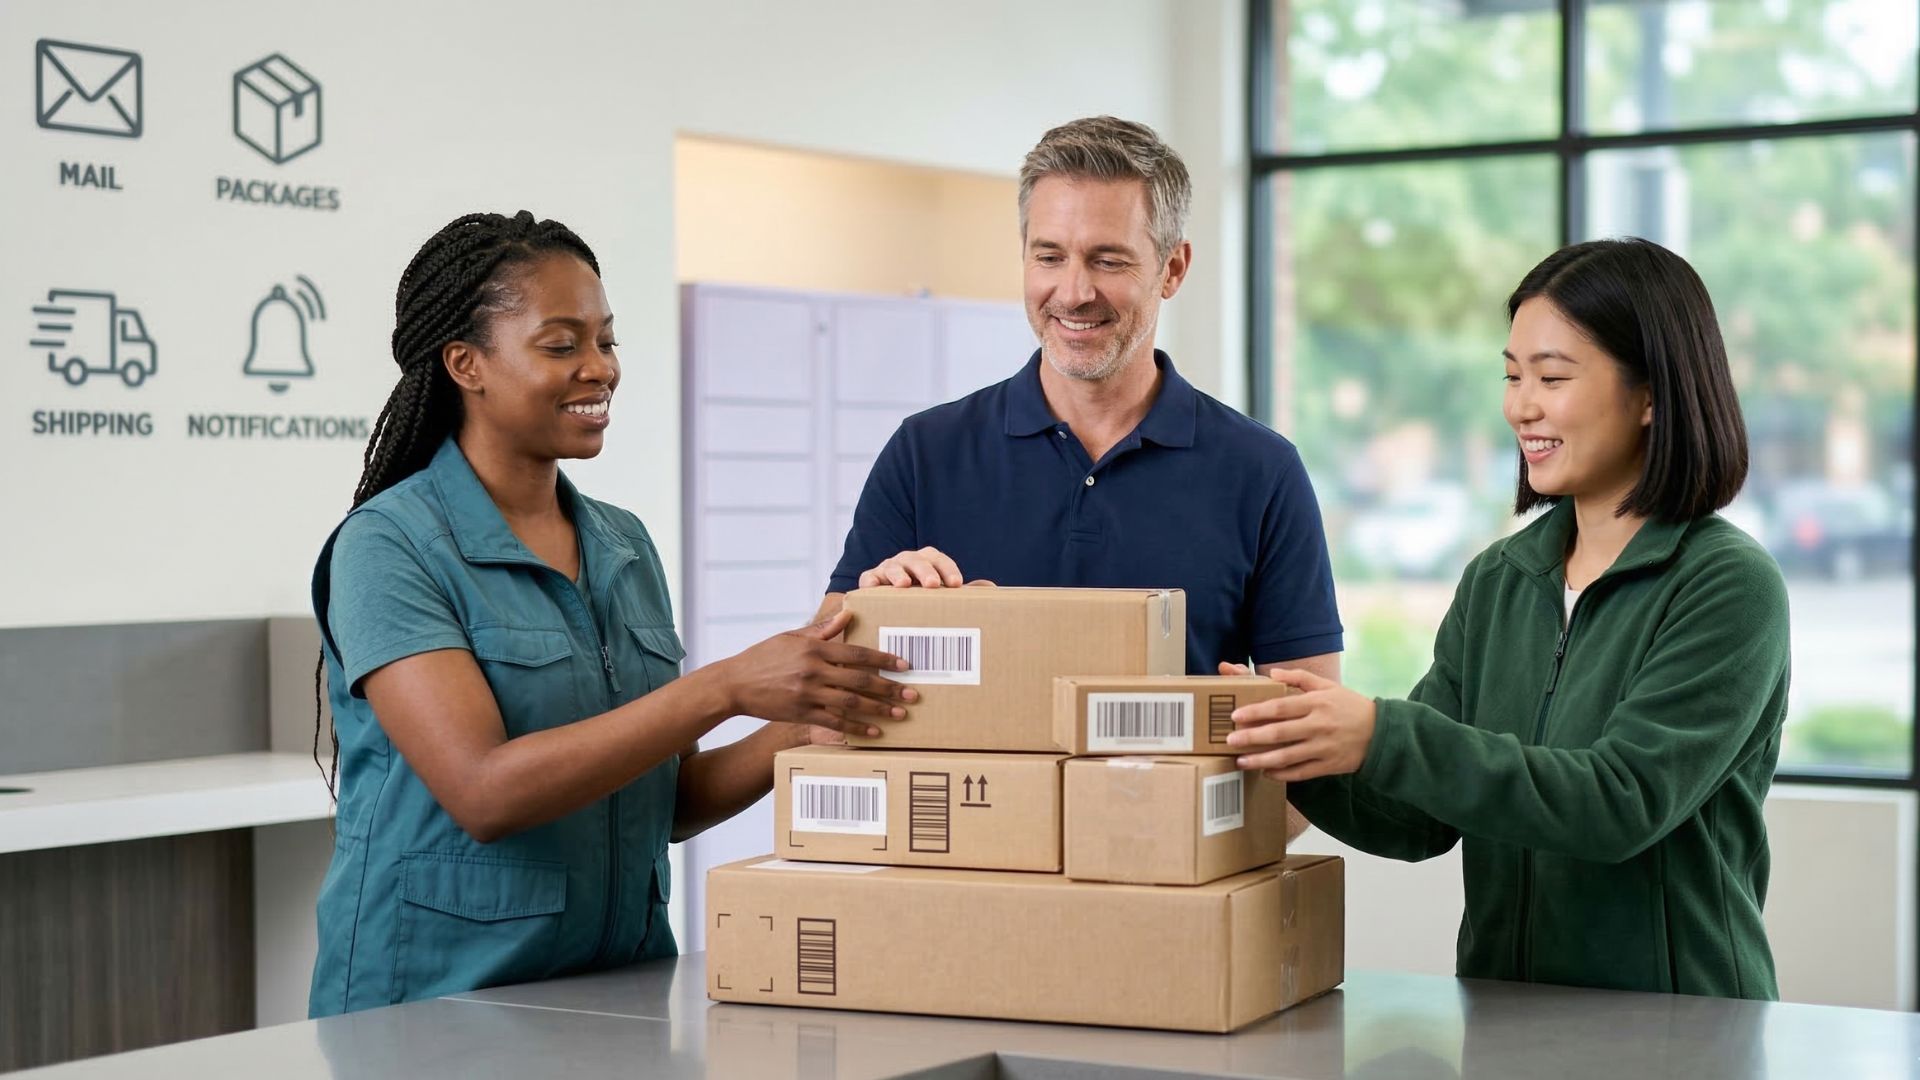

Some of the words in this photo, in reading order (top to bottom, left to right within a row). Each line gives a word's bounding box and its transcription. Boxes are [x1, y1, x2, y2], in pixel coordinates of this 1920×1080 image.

[59, 161, 123, 191] MAIL
[216, 177, 340, 211] PACKAGES
[31, 410, 153, 436] SHIPPING
[187, 413, 369, 440] NOTIFICATIONS
